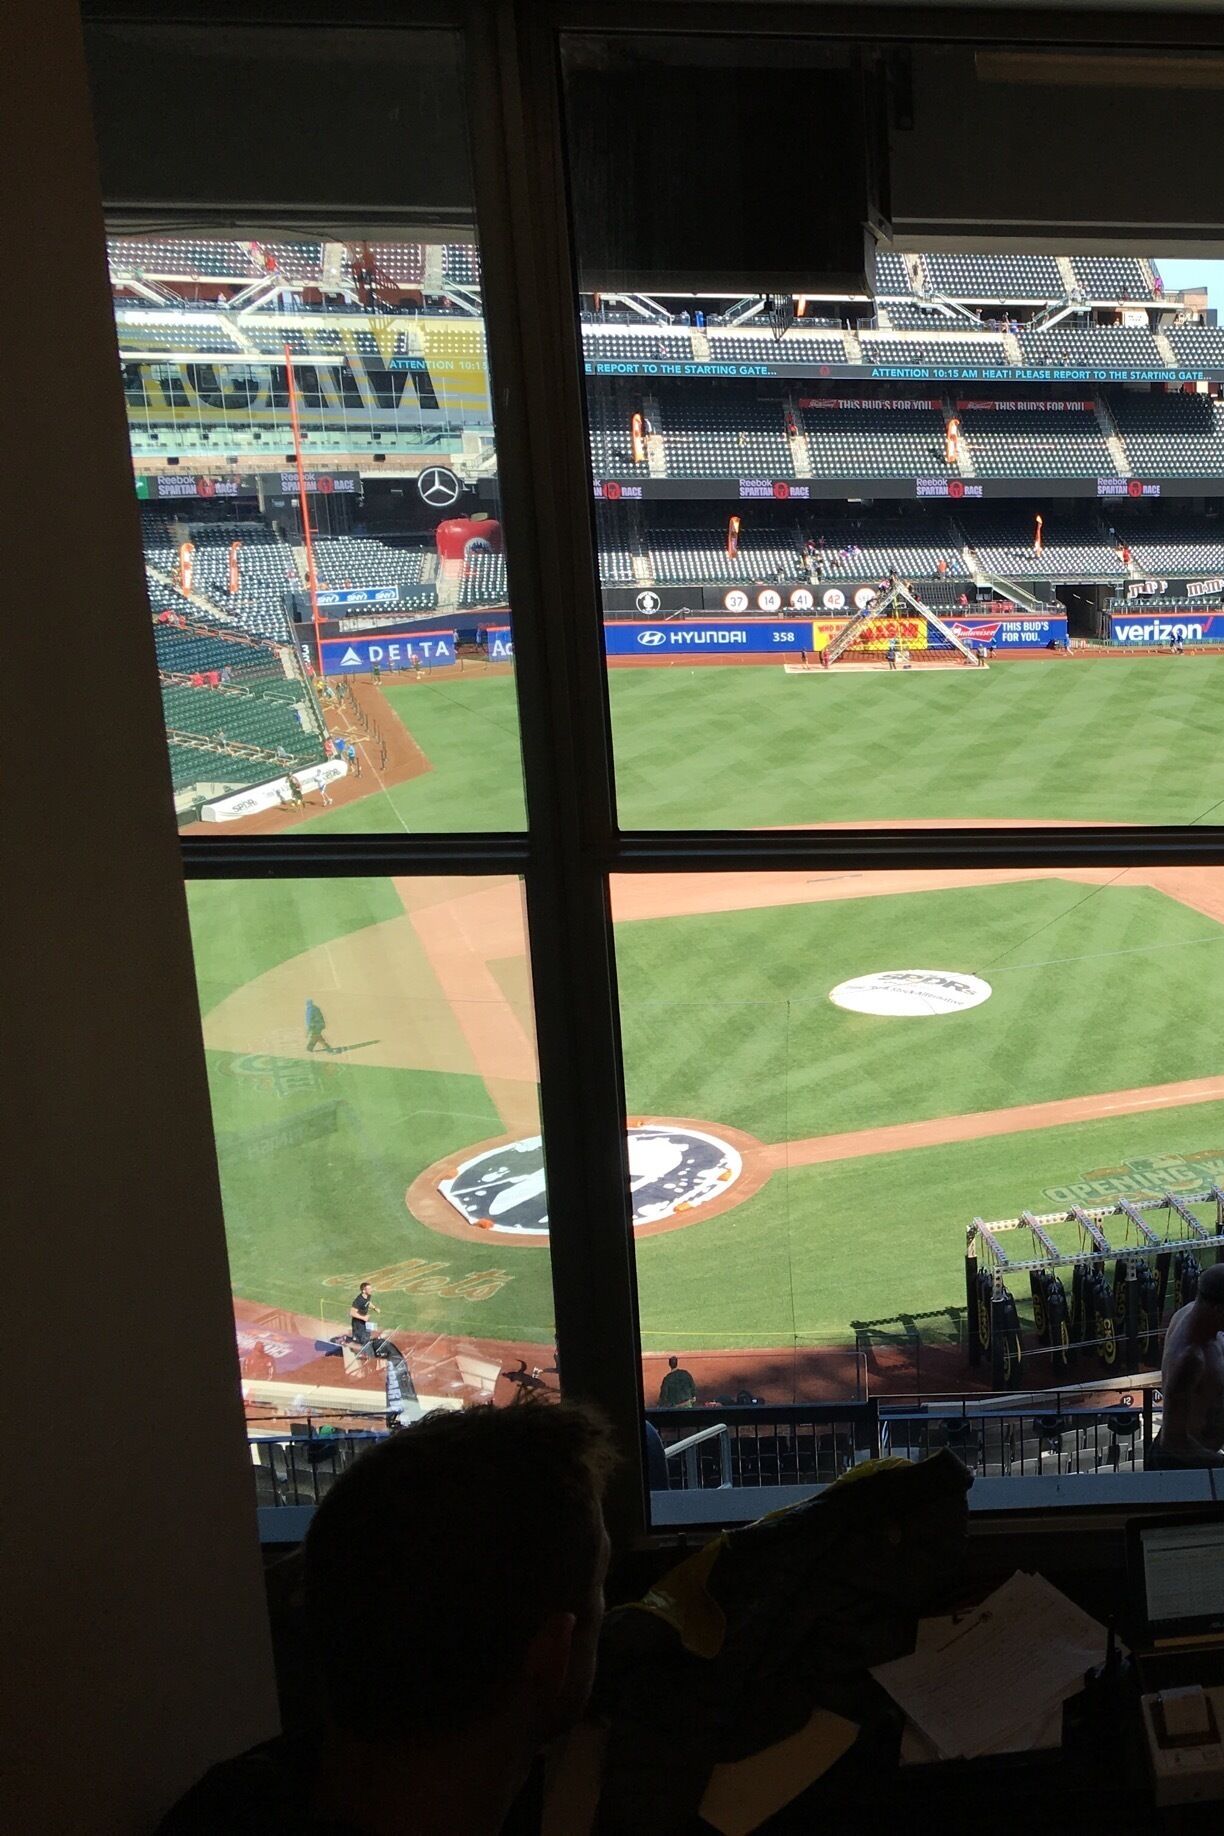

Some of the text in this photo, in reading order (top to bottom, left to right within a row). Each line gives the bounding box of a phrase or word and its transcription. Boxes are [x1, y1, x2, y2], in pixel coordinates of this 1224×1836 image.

[388, 359, 455, 371] ATTENTION
[597, 363, 640, 373] REPORT
[642, 364, 658, 374] TO
[661, 364, 682, 375] THE
[684, 365, 737, 376] STARTING
[871, 368, 929, 378] ATTENTION
[933, 369, 959, 379] 10:15
[961, 369, 978, 379] AM
[982, 369, 1012, 379] HEAT!
[1015, 369, 1051, 380] PLEASE
[1053, 370, 1091, 380] REPORT
[1093, 370, 1107, 380] TO
[1109, 370, 1128, 380] THE
[1130, 370, 1176, 381] STARTING
[334, 479, 355, 490] RACE
[739, 478, 773, 488] Reebok
[916, 478, 948, 487] Reebok
[1097, 477, 1128, 486] Reebok
[158, 484, 197, 496] SPARTAN
[621, 486, 642, 497] RACE
[739, 486, 810, 497] SPARTAN RACE
[916, 486, 983, 496] SPARTAN RACE
[1097, 485, 1161, 495] SPARTAN RACE
[730, 596, 743, 608] 37
[764, 595, 775, 606] 14
[796, 594, 809, 606] 41
[827, 594, 841, 605] 42
[1002, 621, 1050, 632] THIS BUD'S
[1115, 620, 1202, 641] verizon
[670, 631, 747, 644] HYUNDAI
[772, 631, 795, 643] 358
[1002, 632, 1041, 642] FOR YOU.
[369, 640, 450, 663] DELTA
[1047, 1164, 1198, 1203] OPENING
[1103, 1317, 1114, 1353] CKO
[1123, 1396, 1132, 1406] 12
